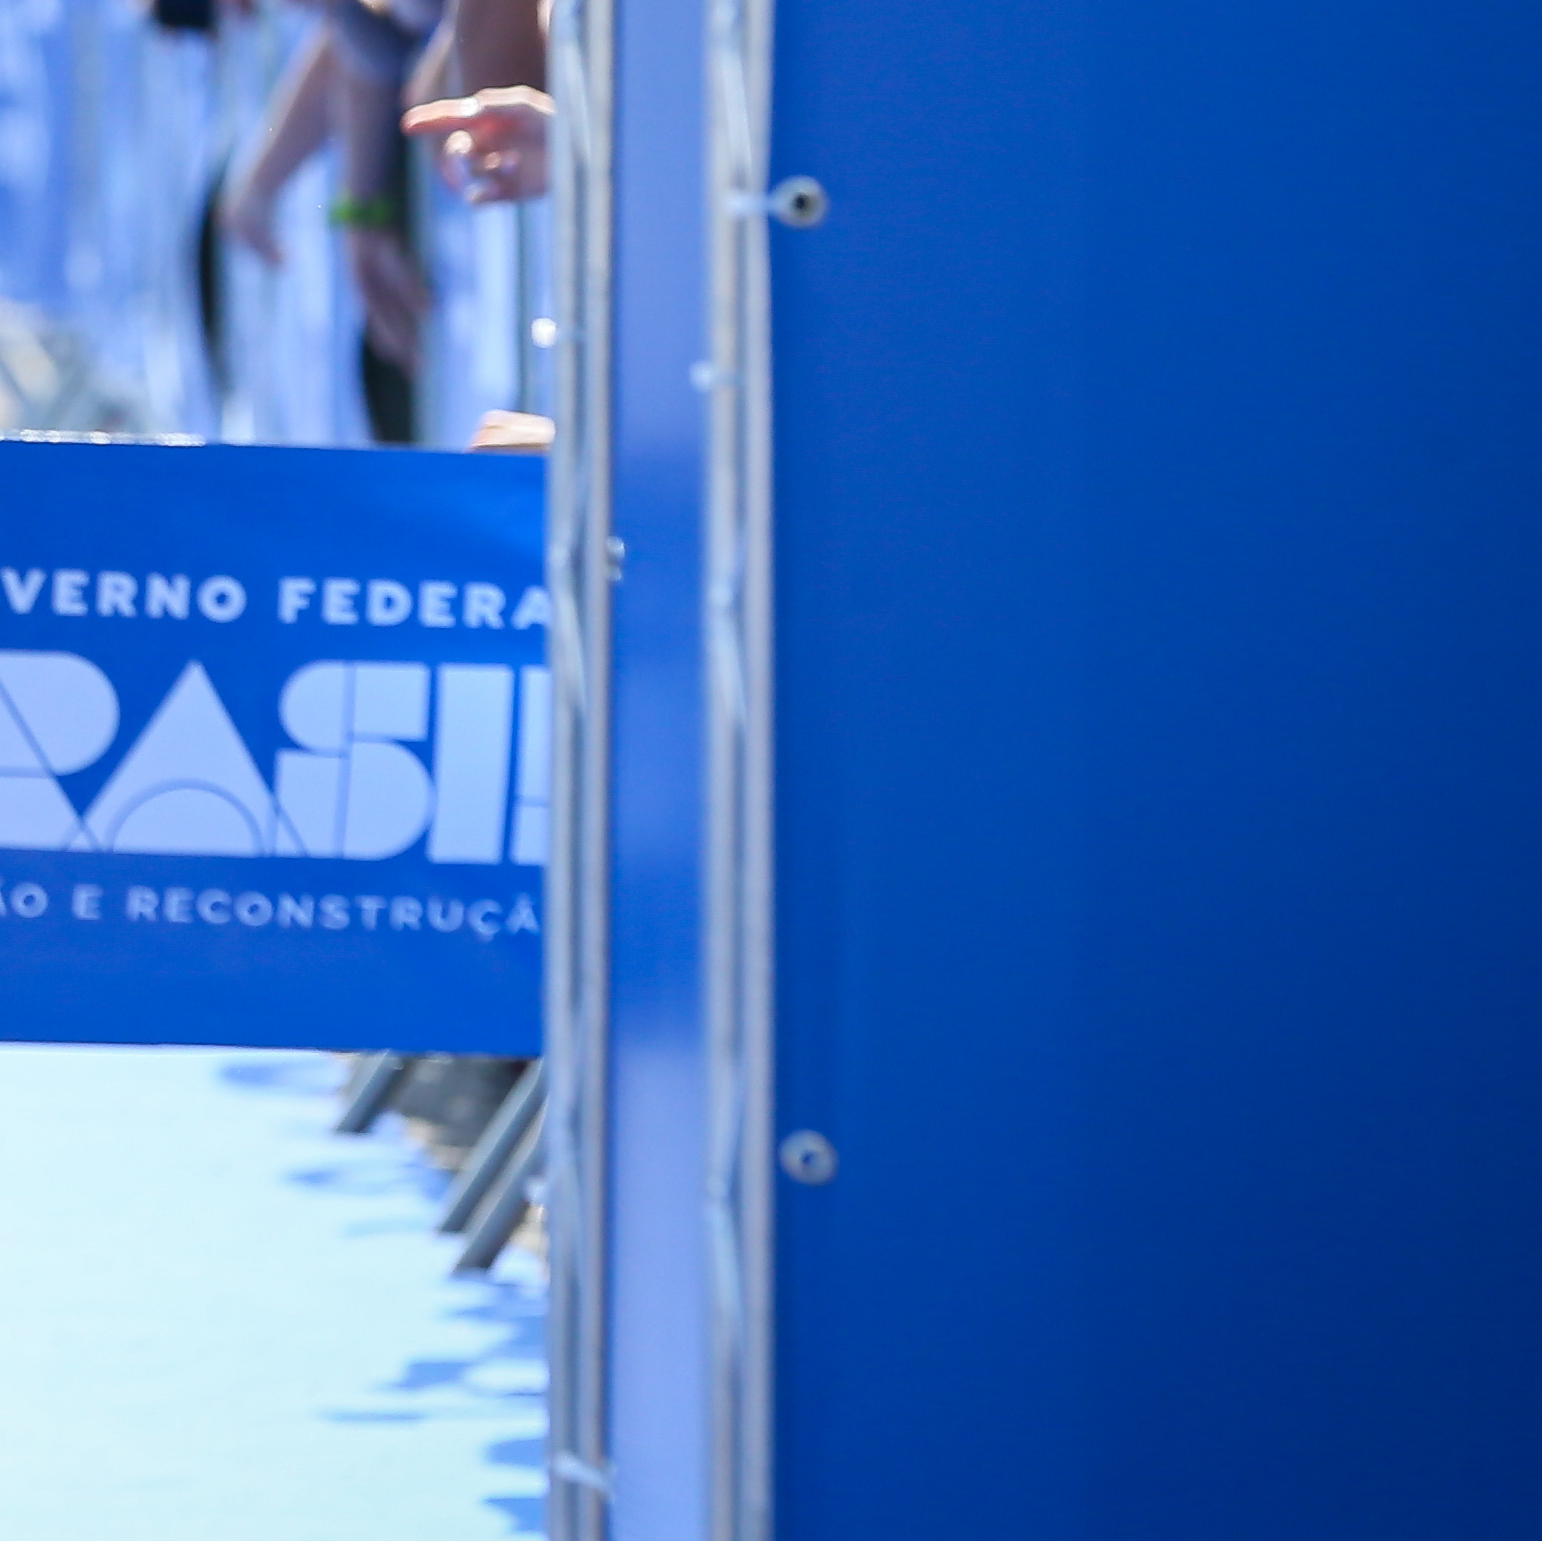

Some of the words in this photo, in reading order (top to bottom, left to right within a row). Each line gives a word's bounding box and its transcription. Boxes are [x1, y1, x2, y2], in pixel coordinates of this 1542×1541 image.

[278, 577, 549, 631] FEDERA
[71, 883, 102, 921] E
[124, 886, 541, 942] RECONSTRUÇÃ
